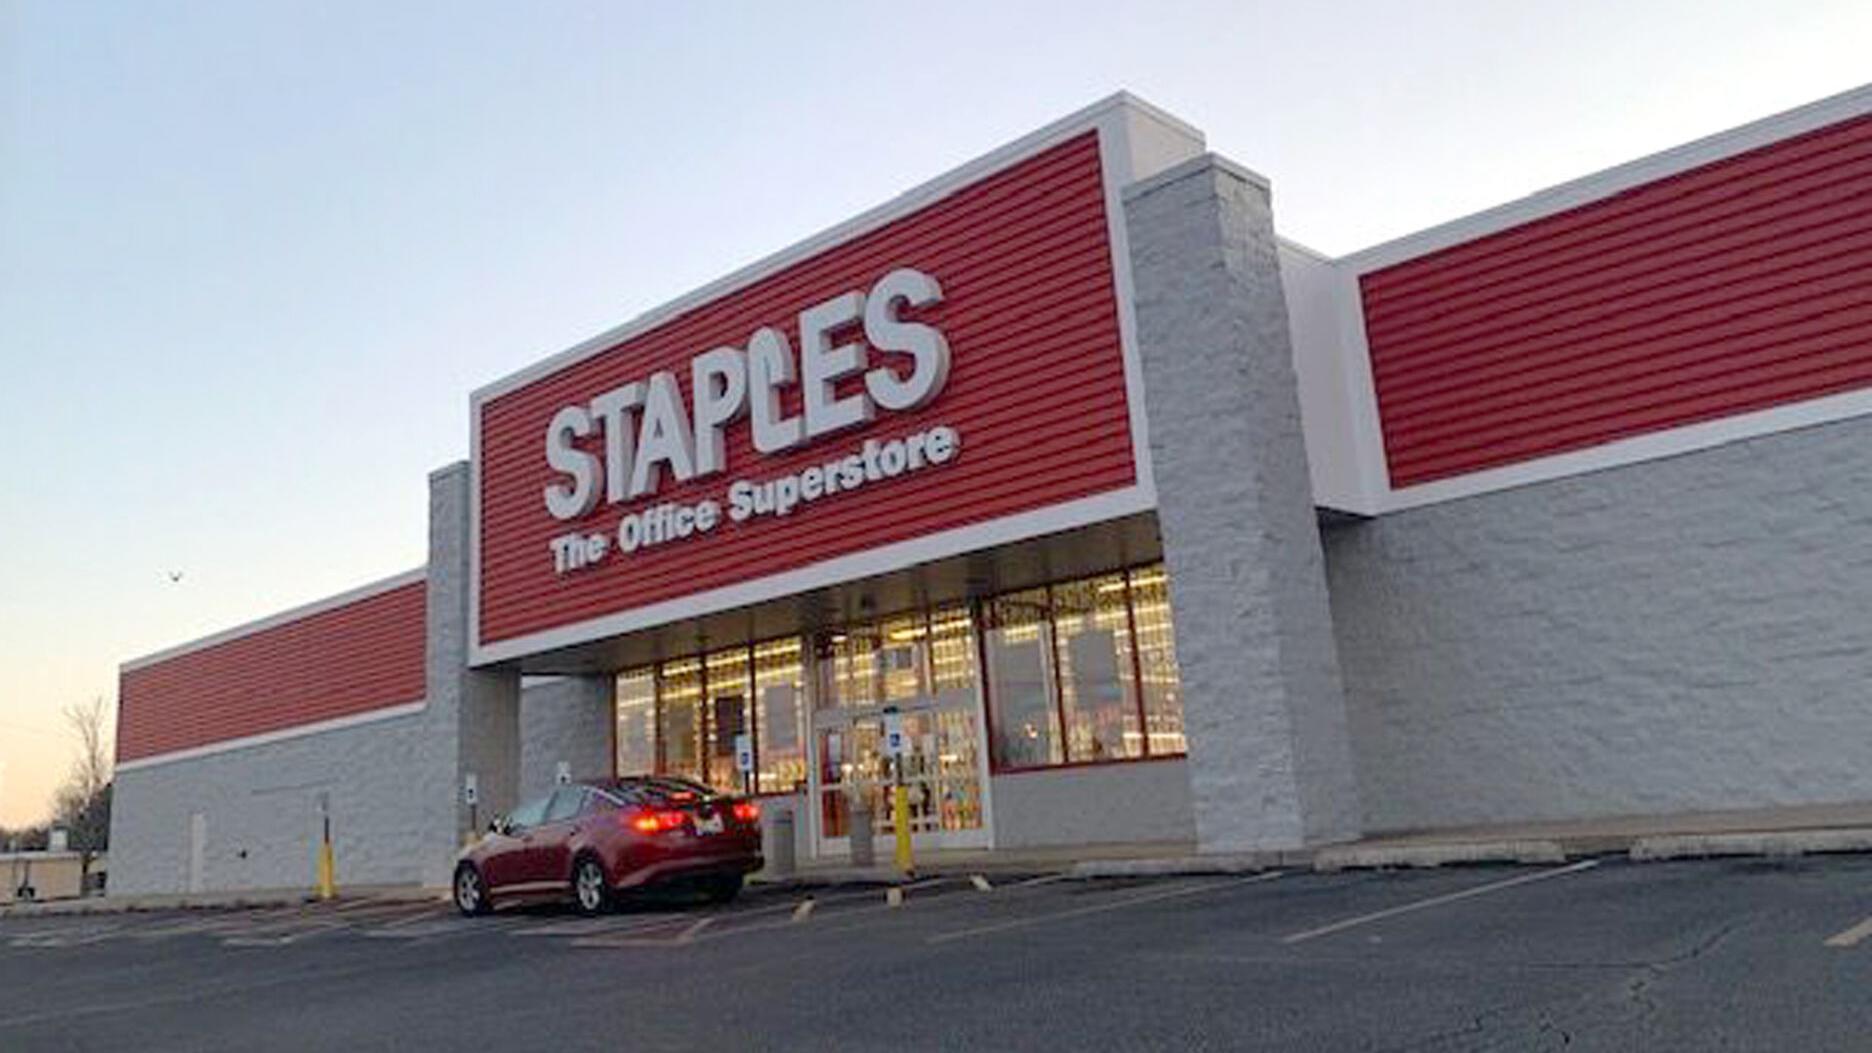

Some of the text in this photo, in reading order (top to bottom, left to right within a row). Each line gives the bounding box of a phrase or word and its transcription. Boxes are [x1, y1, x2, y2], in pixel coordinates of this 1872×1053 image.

[545, 268, 950, 520] STAPLES
[550, 426, 957, 573] The Office Superstore
